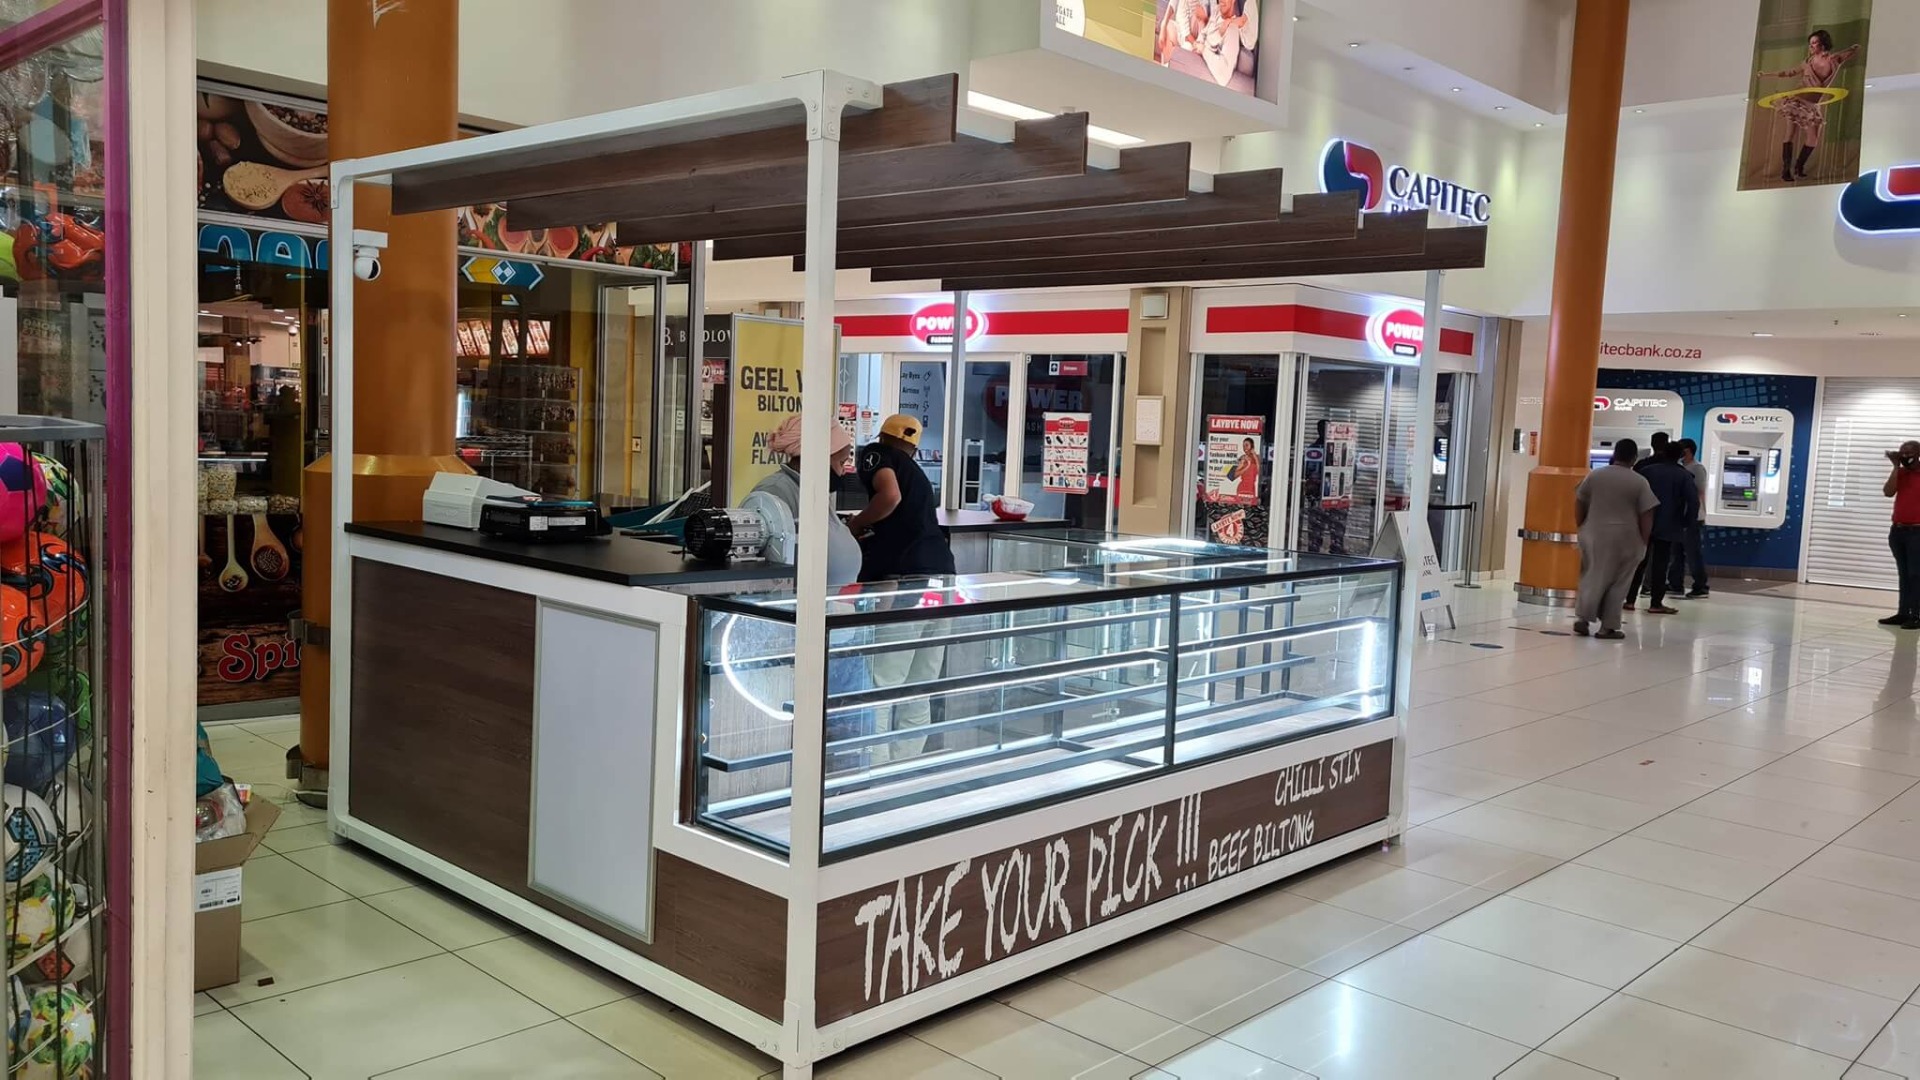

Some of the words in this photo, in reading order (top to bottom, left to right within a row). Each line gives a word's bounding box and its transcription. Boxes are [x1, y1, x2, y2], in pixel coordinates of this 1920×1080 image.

[1389, 166, 1491, 222] CAPITEC
[915, 316, 973, 331] POWR
[1386, 321, 1424, 341] POWE
[1600, 342, 1702, 359] itecbank.co.za
[741, 366, 788, 392] GEEL
[757, 395, 803, 413] BILTON
[995, 385, 1082, 411] PWER
[1613, 398, 1668, 408] CAPITEC
[1211, 418, 1239, 429] LAYBYE
[1240, 420, 1259, 430] NOW
[1741, 414, 1783, 422] CAPITEC
[751, 450, 790, 465] FLAV
[217, 632, 301, 682] Spi
[1274, 756, 1325, 806] CHILLI
[1328, 750, 1361, 789] STIX
[1208, 828, 1250, 882] BEEF
[1253, 810, 1314, 866] BILTONG
[855, 859, 971, 1004] TAKE
[981, 837, 1072, 961] YOUR
[1086, 806, 1168, 926] PICK
